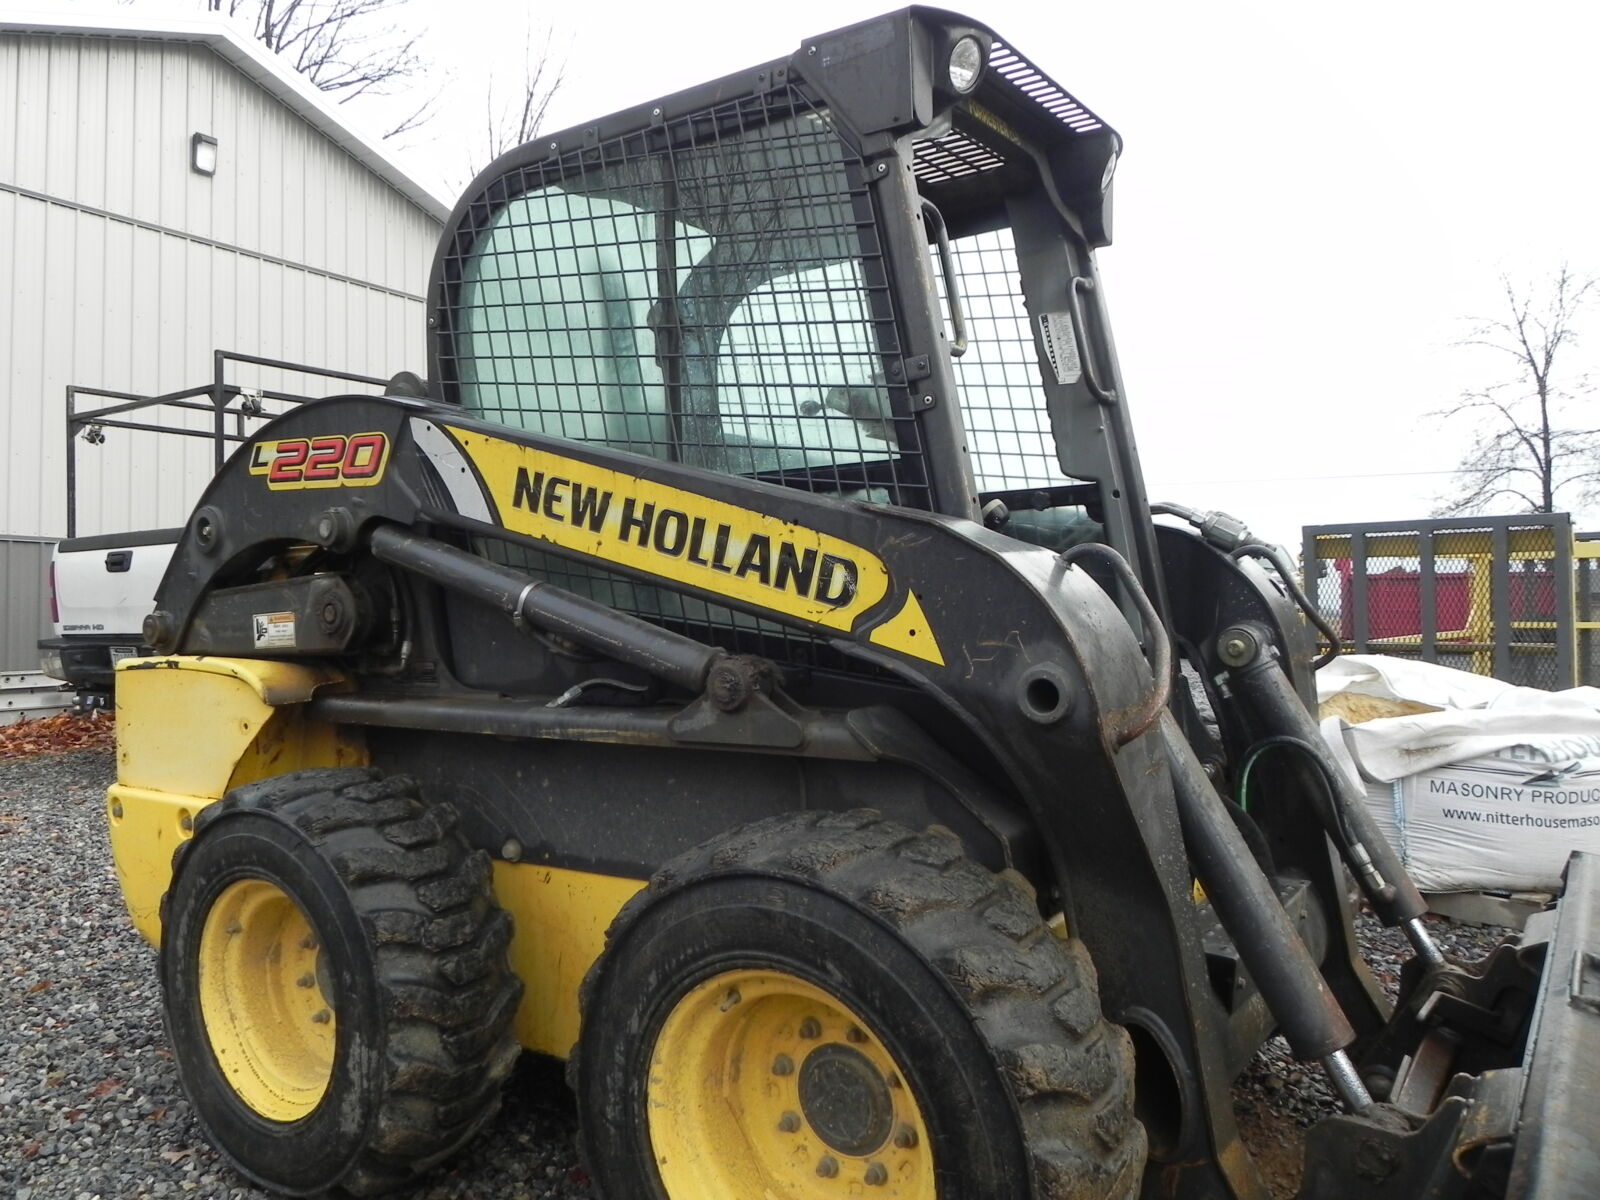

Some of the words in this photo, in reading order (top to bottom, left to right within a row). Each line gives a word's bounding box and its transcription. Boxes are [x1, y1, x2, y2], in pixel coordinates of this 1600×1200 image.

[251, 434, 387, 483] L220
[512, 466, 613, 534] NEW
[618, 497, 859, 608] HOLLAND
[1430, 780, 1524, 801] MASONRY
[1531, 788, 1600, 804] PRODUC
[1442, 808, 1600, 828] www.nitterhousemaso
